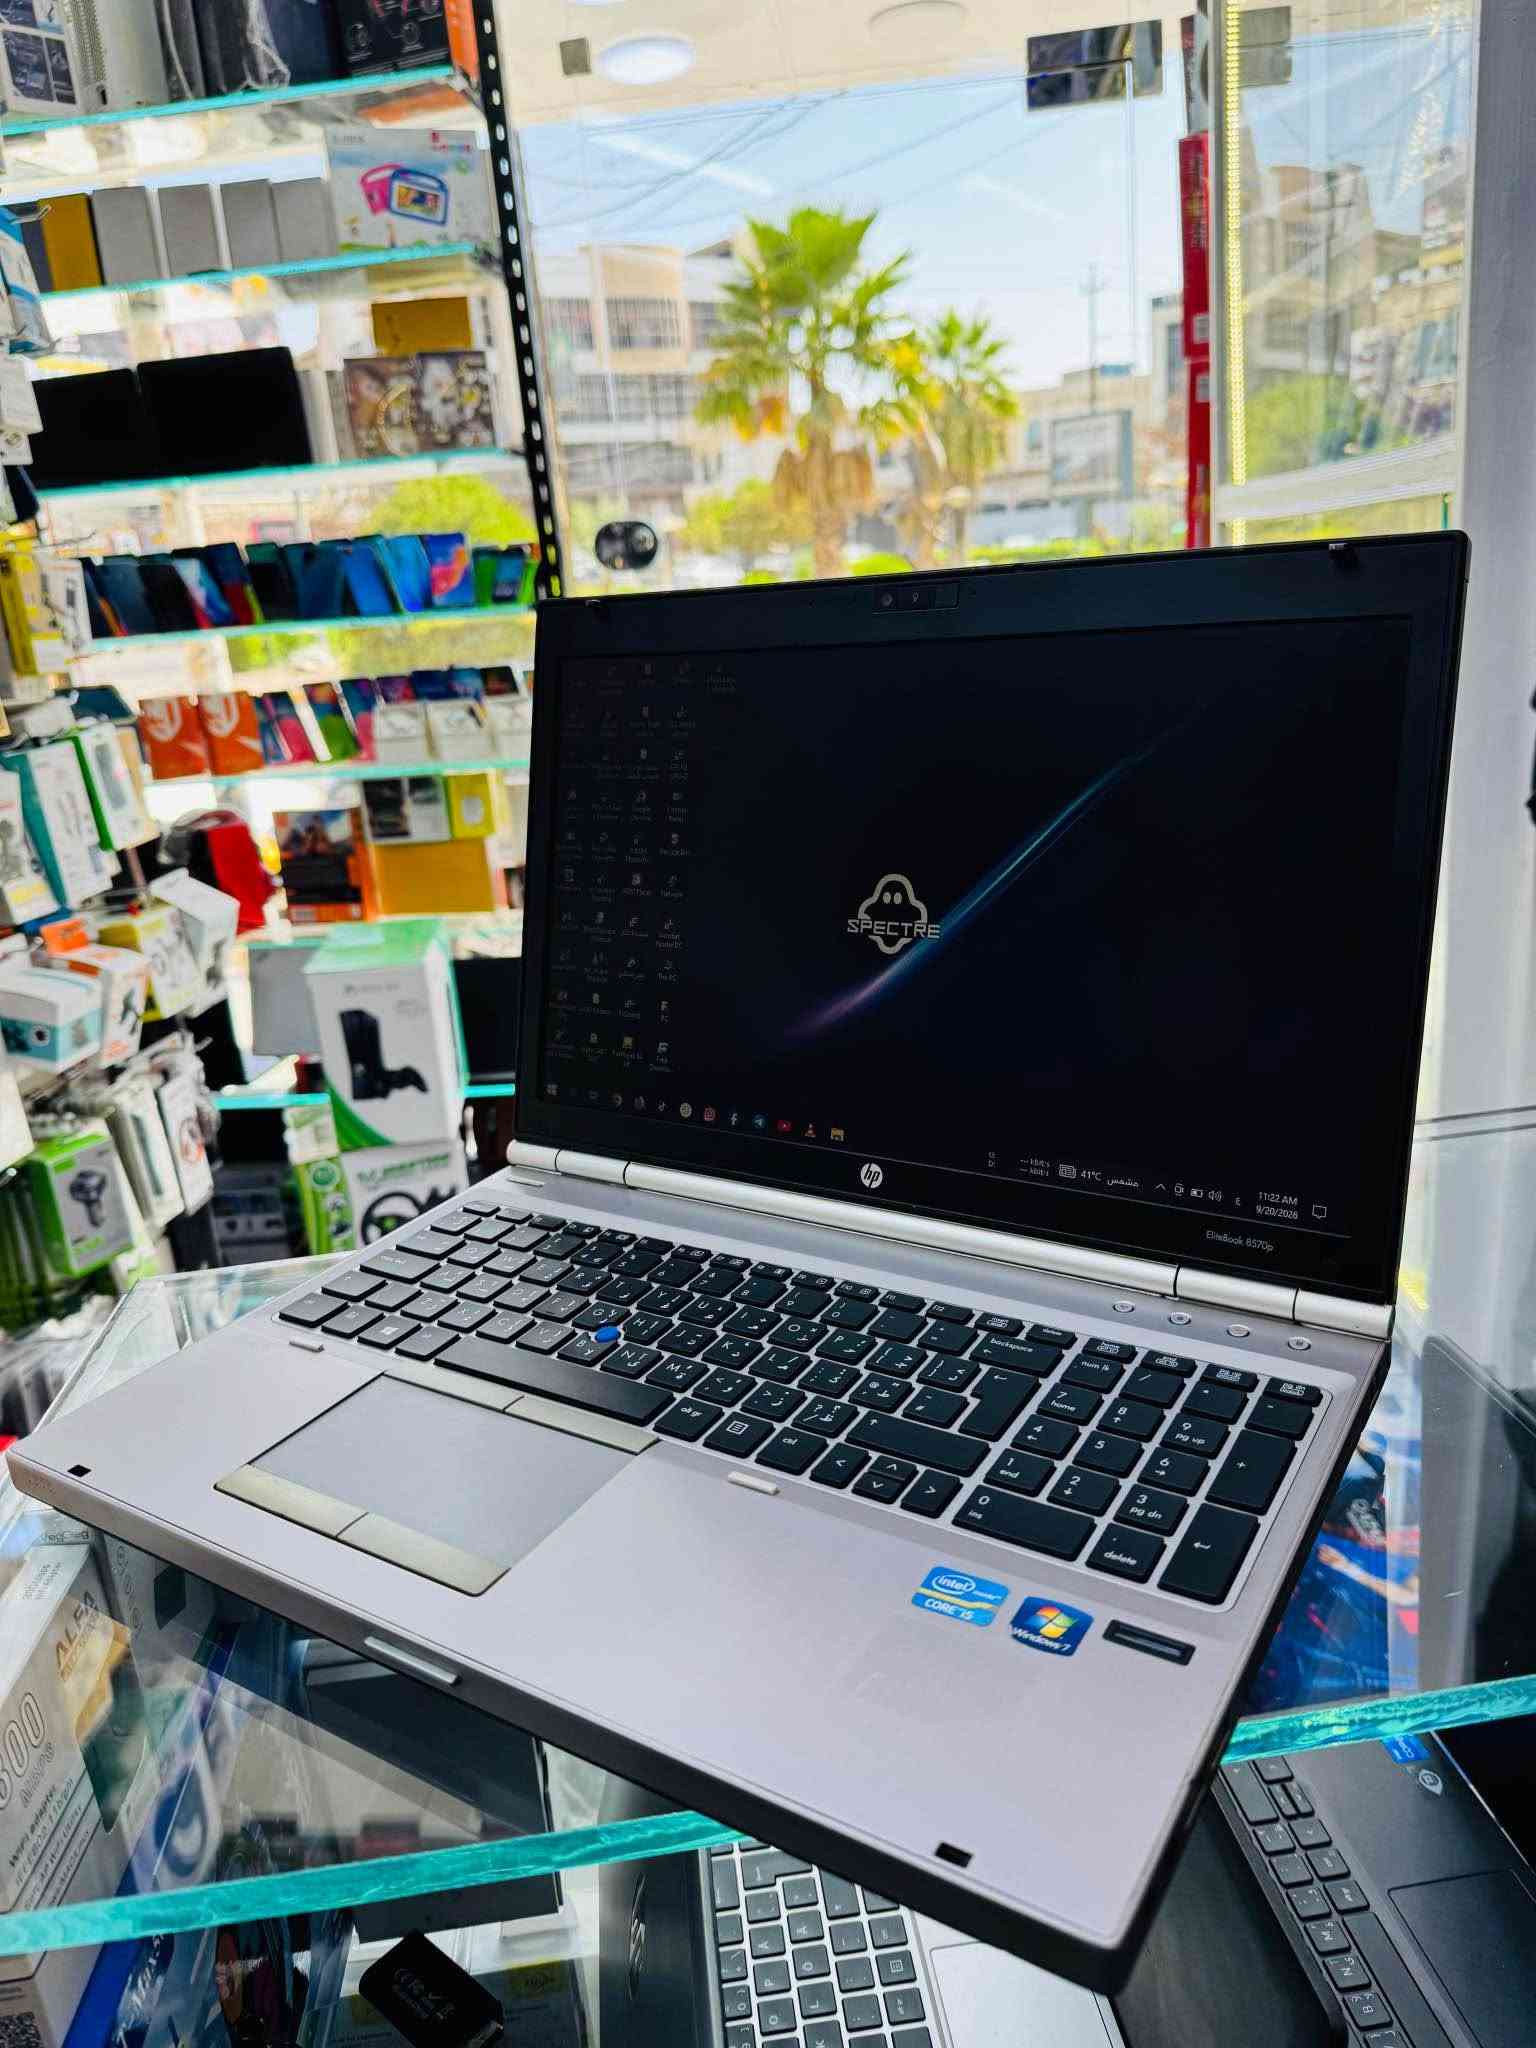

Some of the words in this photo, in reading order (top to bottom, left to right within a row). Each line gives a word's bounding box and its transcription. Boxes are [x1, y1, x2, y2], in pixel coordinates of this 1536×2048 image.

[847, 919, 941, 939] SPECTRE
[861, 1163, 883, 1188] hp
[1281, 1195, 1299, 1206] AM
[1206, 1229, 1244, 1246] EliteBook
[1050, 1399, 1077, 1412] home
[1094, 1440, 1106, 1450] 5
[1159, 1457, 1170, 1467] 6
[998, 1468, 1021, 1480] end
[1069, 1475, 1082, 1486] 2
[977, 1495, 991, 1506] 0
[1136, 1494, 1148, 1504] 3
[1128, 1506, 1146, 1518] pg
[1146, 1509, 1163, 1520] dn
[1104, 1551, 1138, 1566] delete
[924, 1598, 961, 1617] CORE
[1013, 1626, 1062, 1650] Windows
